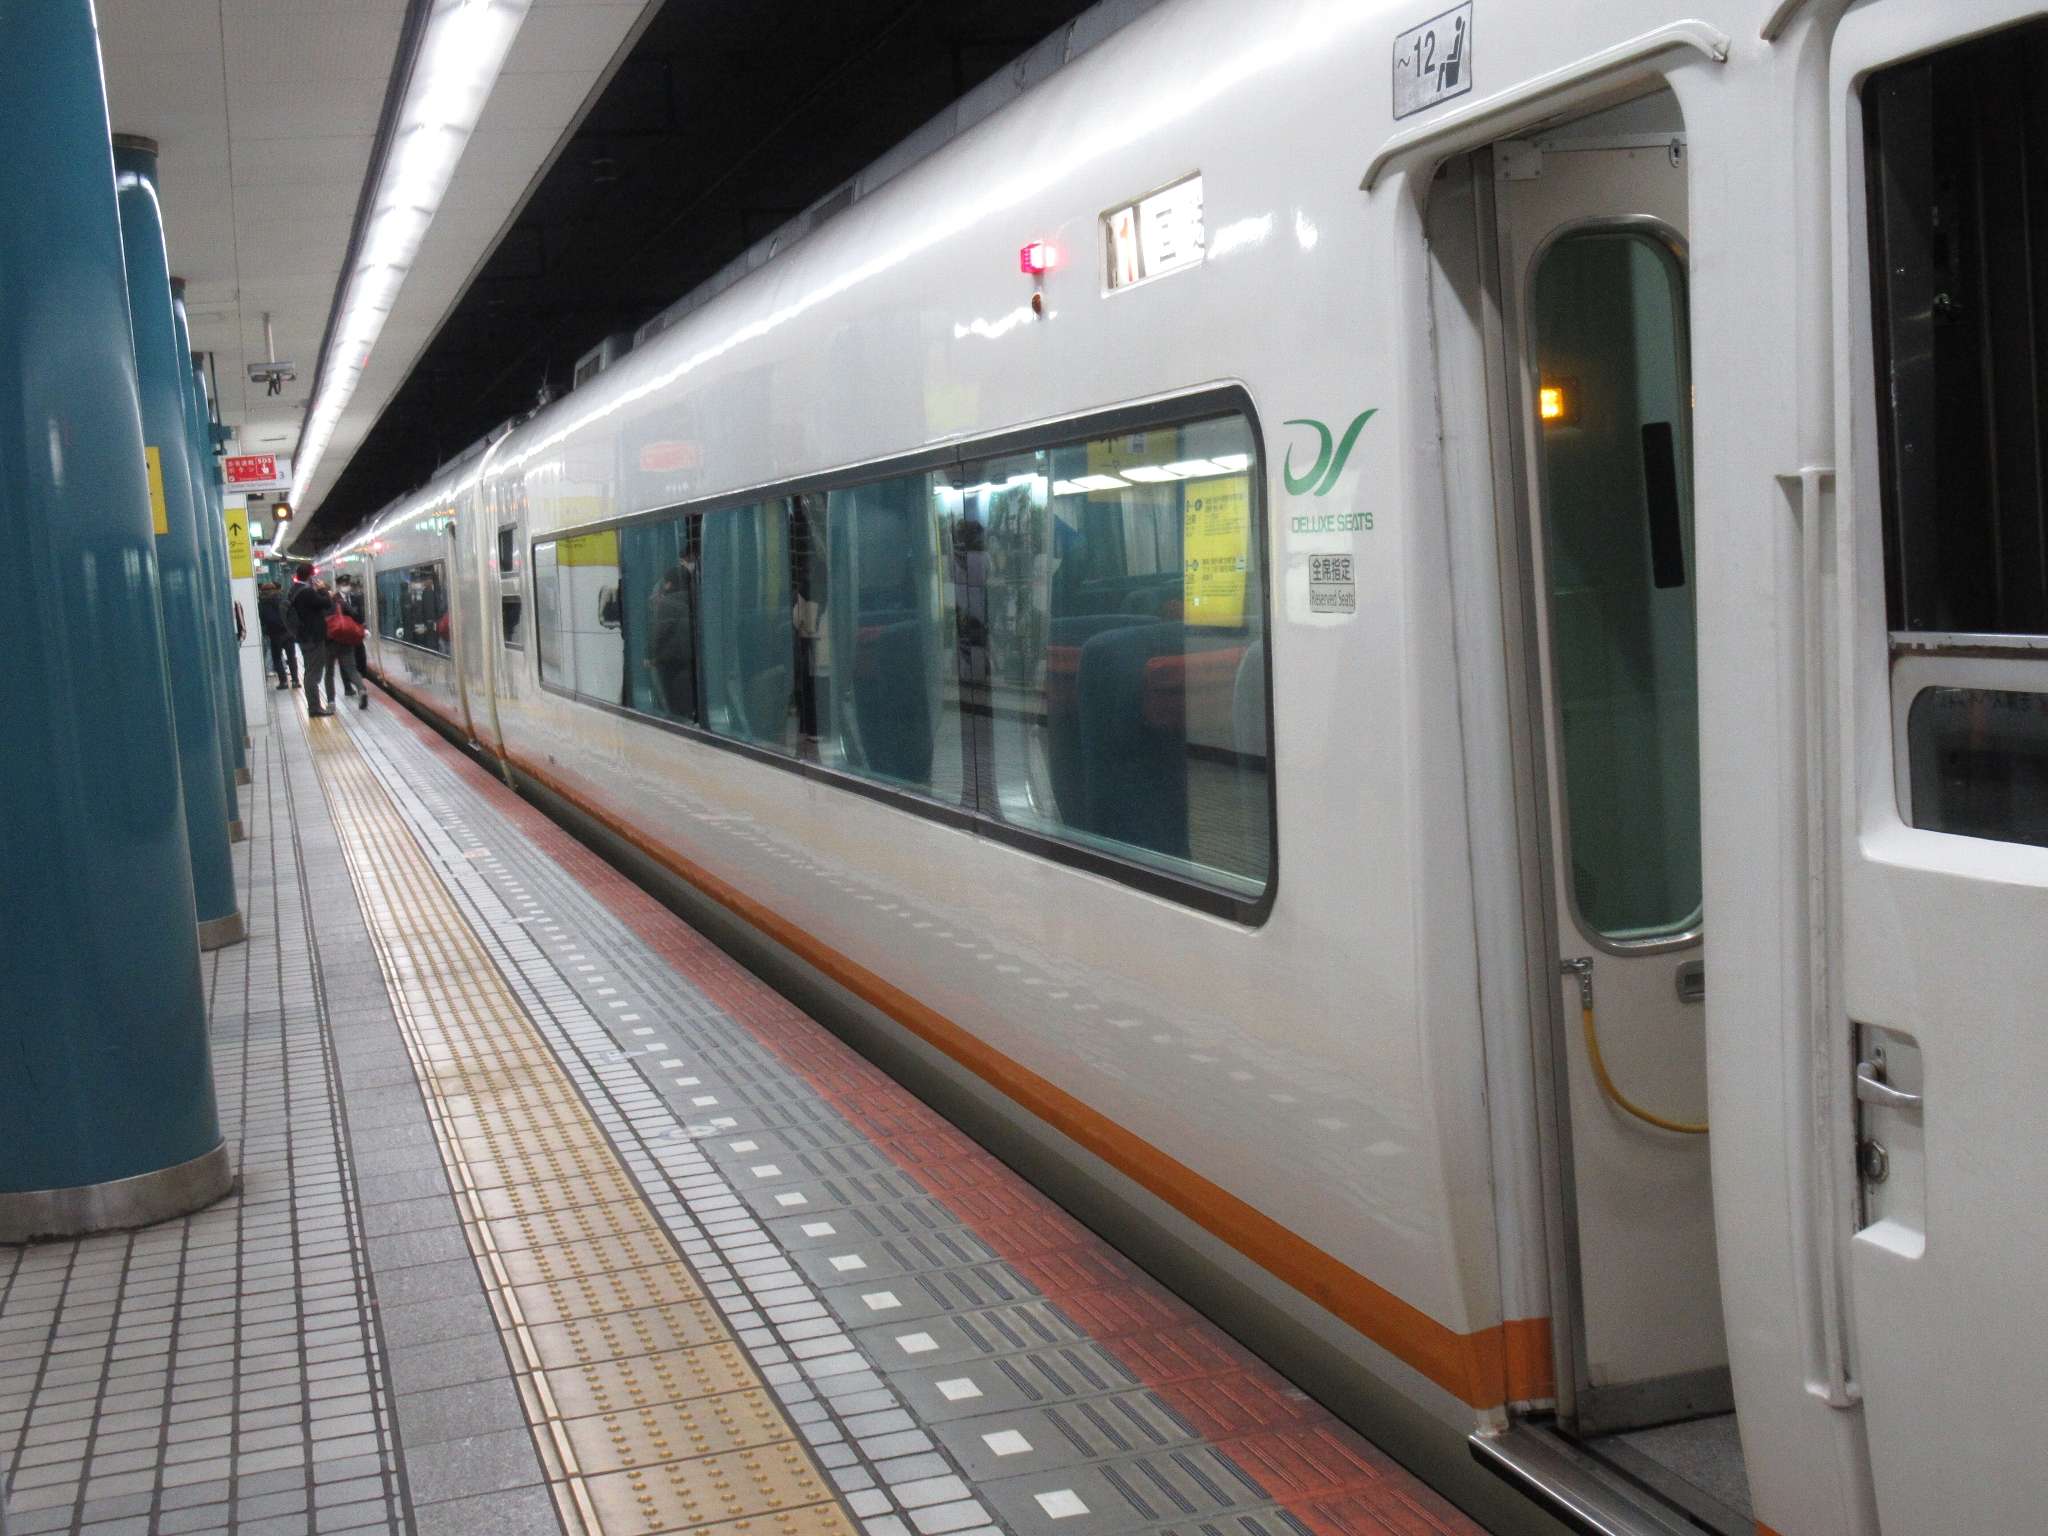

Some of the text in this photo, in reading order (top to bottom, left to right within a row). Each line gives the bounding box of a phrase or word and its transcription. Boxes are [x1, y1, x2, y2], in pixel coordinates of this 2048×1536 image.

[1291, 511, 1374, 533] DELUXE SEATS
[1312, 558, 1352, 581] 全席指定
[1311, 590, 1354, 607] Reserved Seats
